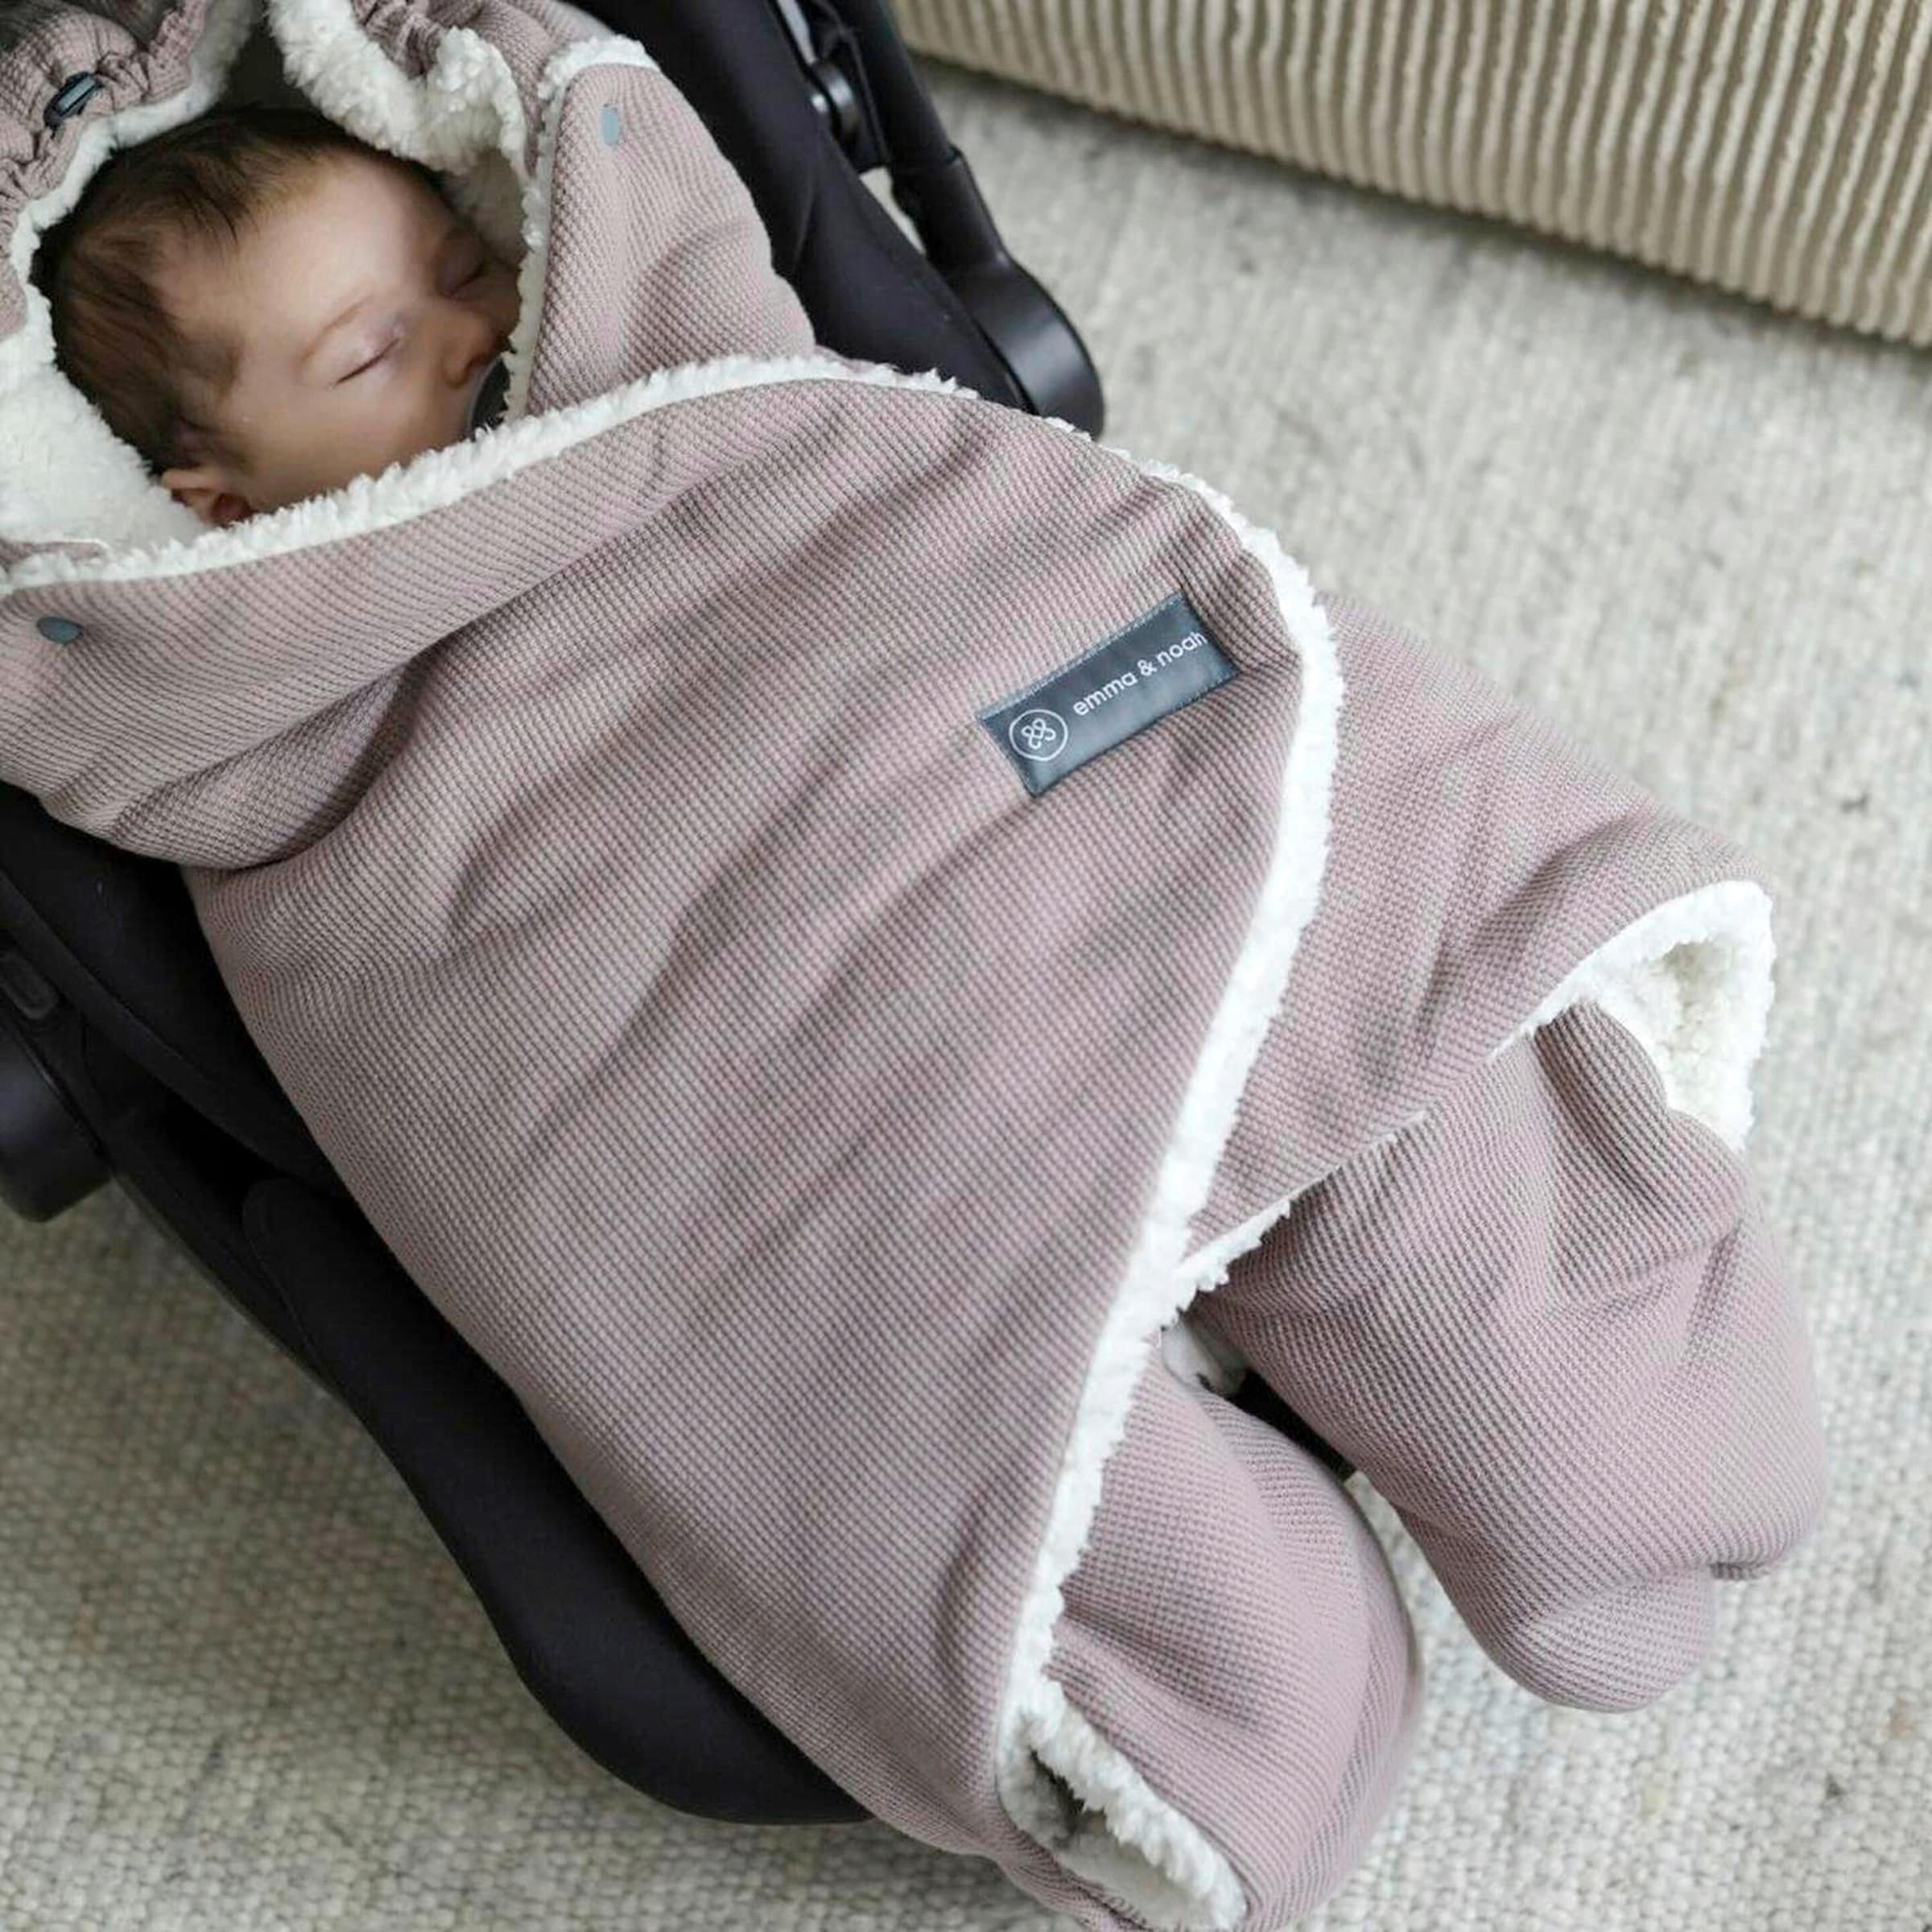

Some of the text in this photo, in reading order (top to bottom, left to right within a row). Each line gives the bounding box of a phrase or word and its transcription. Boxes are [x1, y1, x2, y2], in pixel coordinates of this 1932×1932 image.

[1072, 630, 1208, 716] emma & noah
